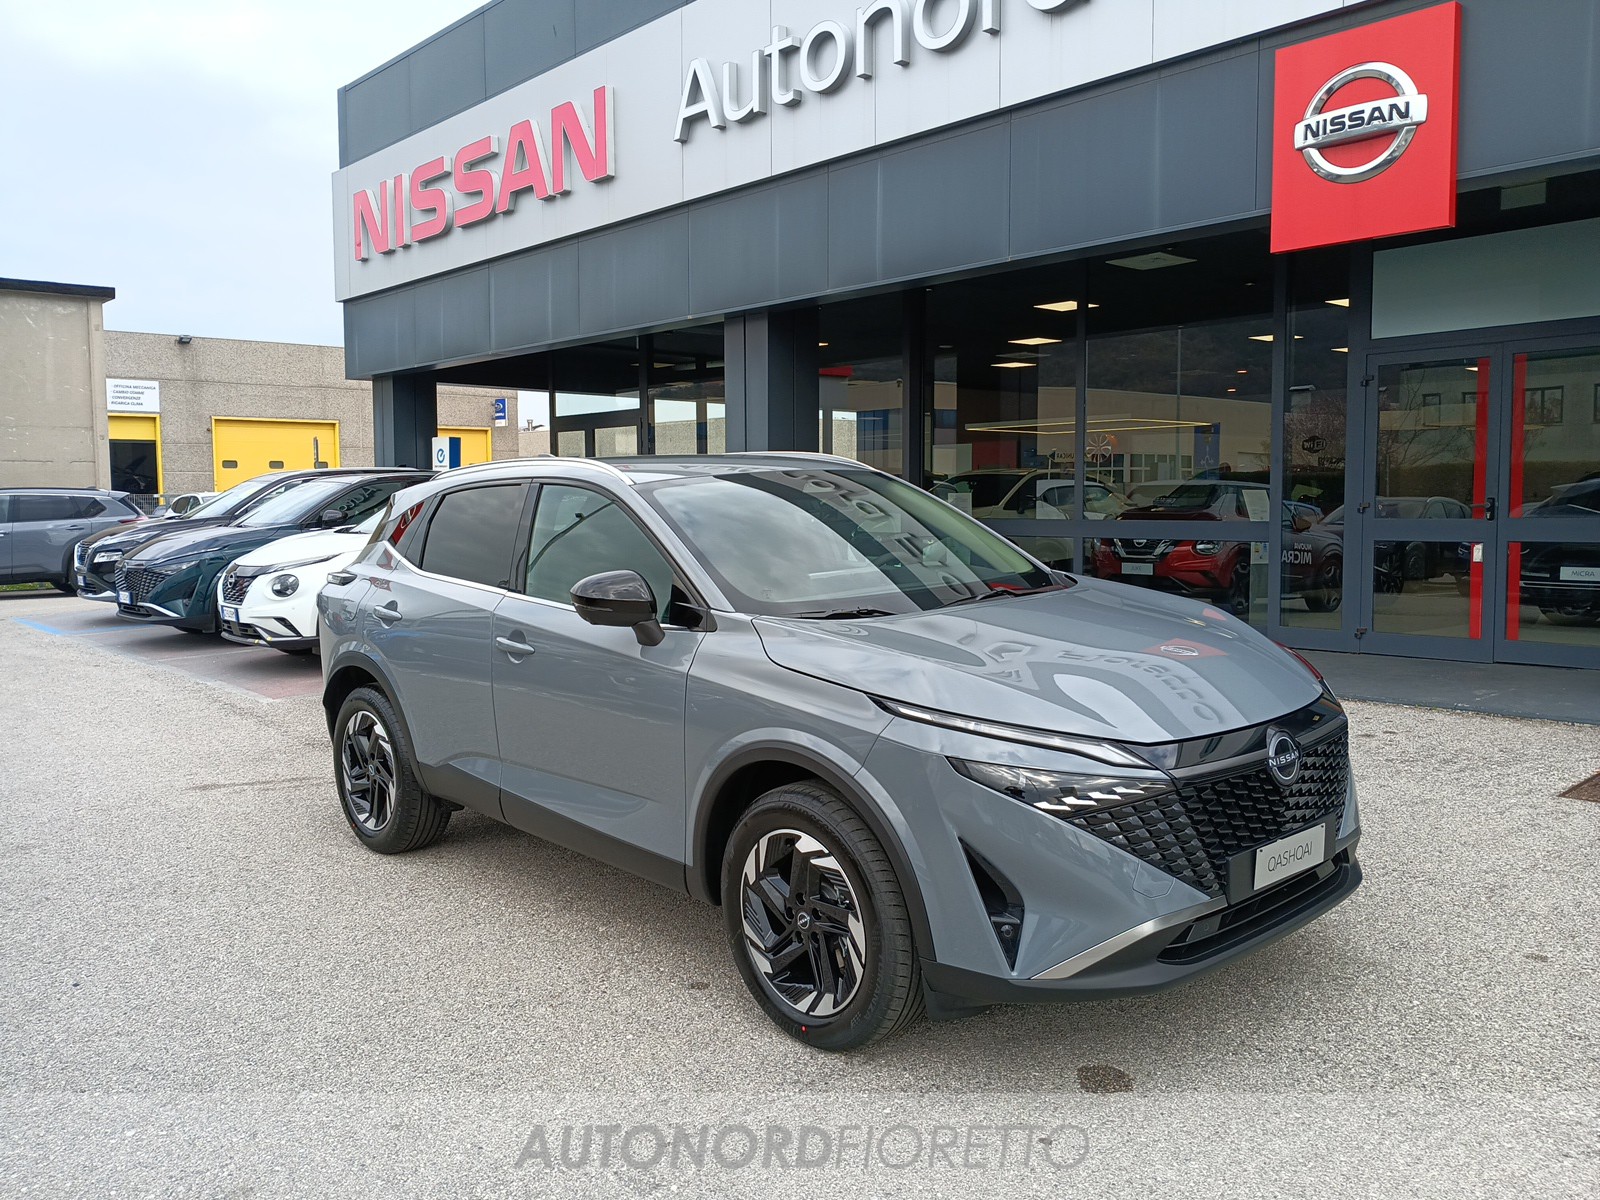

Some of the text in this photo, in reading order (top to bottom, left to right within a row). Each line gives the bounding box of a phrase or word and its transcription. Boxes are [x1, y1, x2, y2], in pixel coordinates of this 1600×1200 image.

[673, 0, 1092, 143] Autono
[1303, 101, 1411, 142] NISSAN
[353, 85, 614, 262] NISSAN
[1570, 569, 1596, 577] MICRA
[1268, 750, 1300, 767] NISSAN
[1267, 840, 1313, 873] QASHQAI
